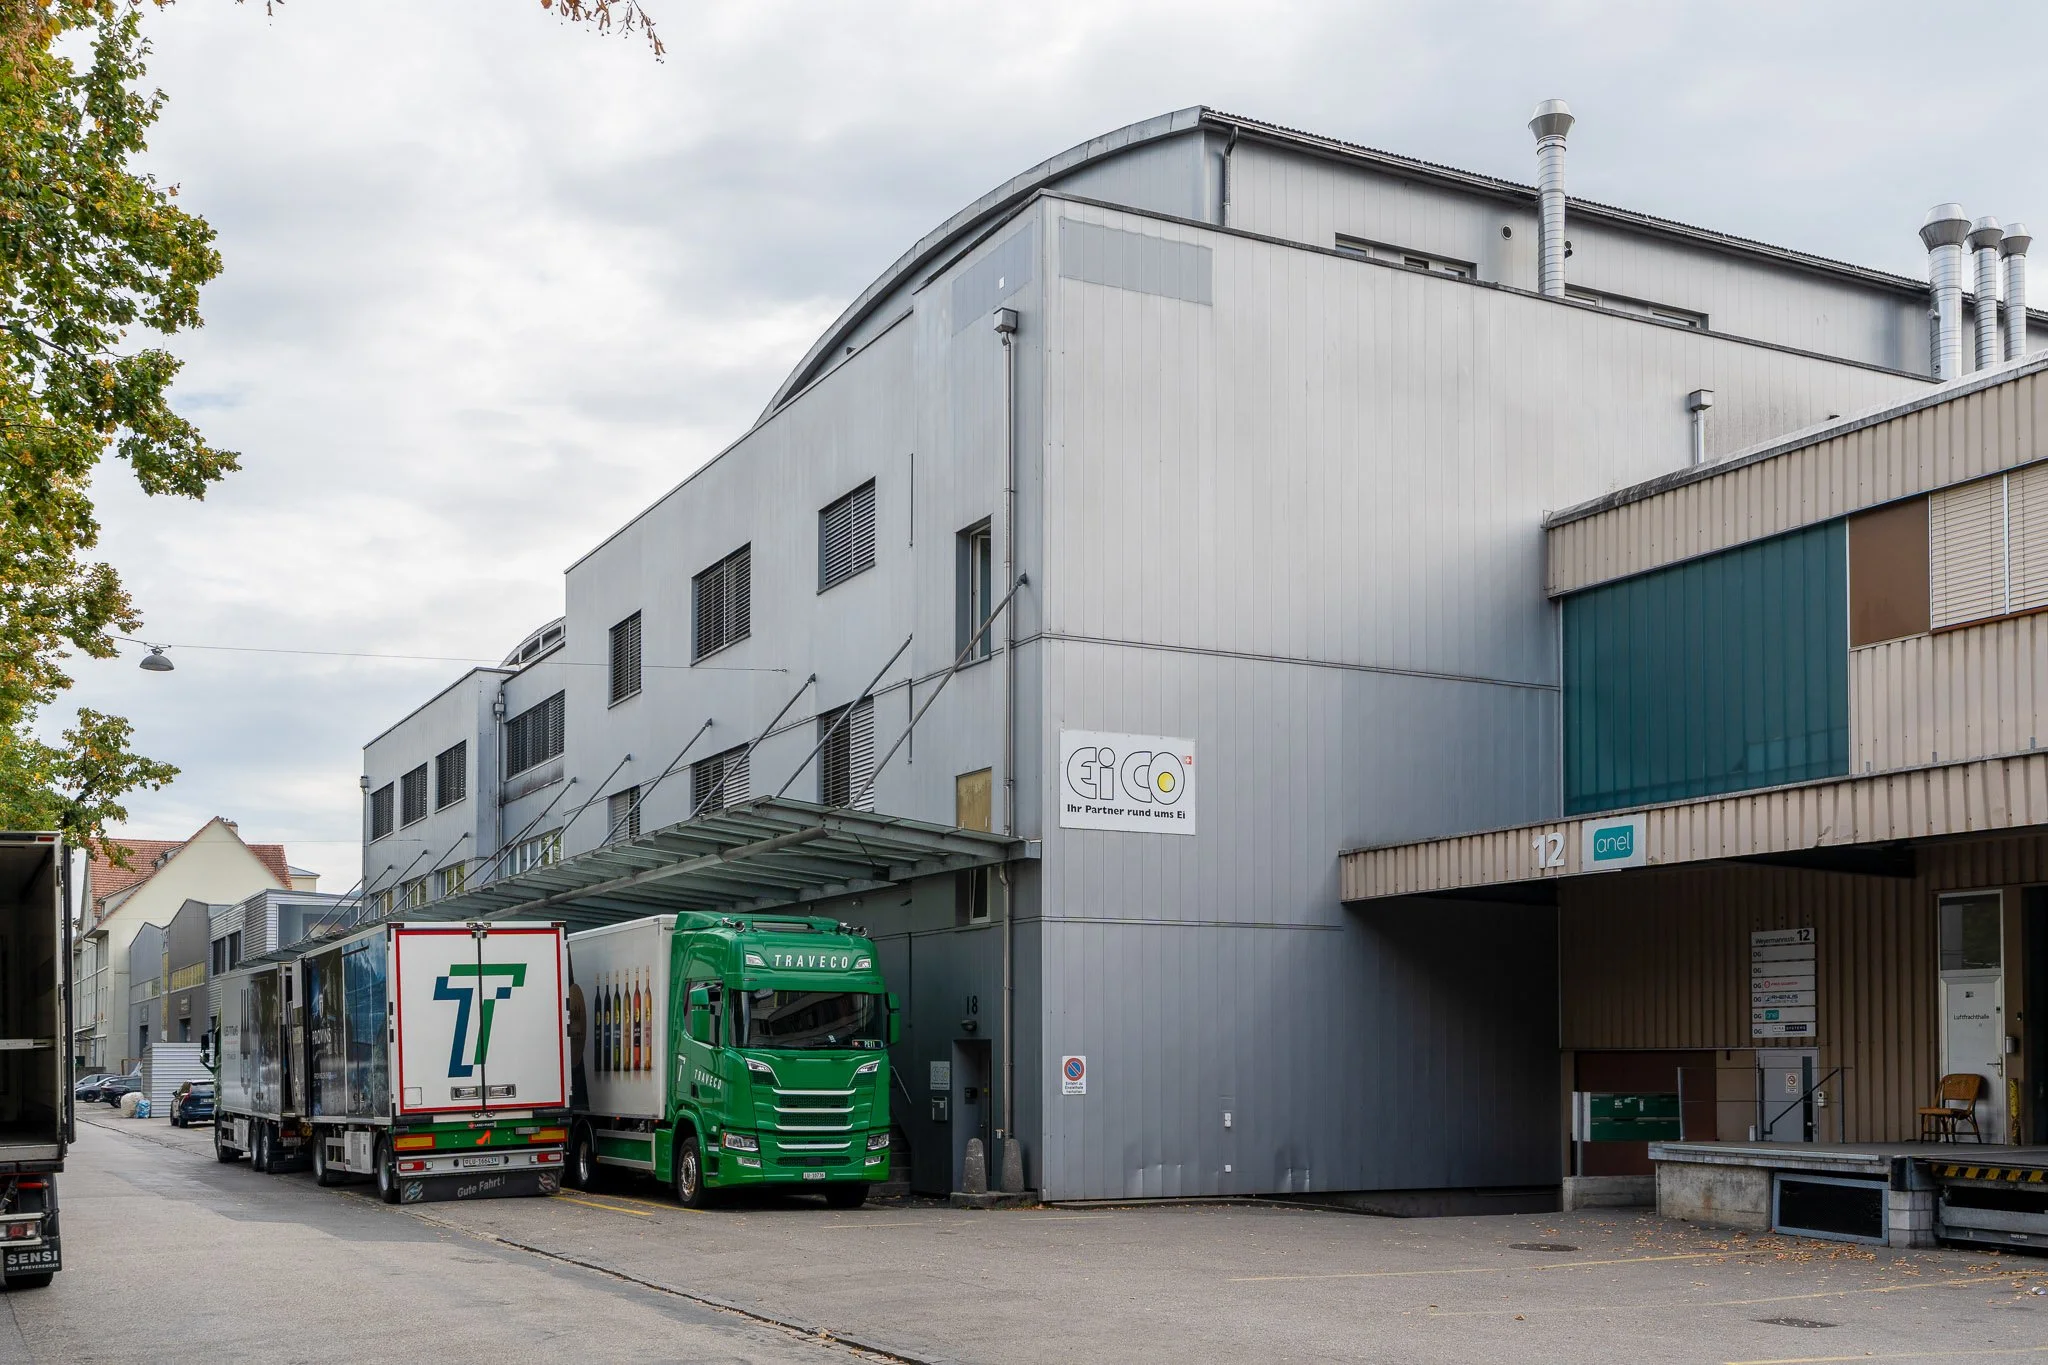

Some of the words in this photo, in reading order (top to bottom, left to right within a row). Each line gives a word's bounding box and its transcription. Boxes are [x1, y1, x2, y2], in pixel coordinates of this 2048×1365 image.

[1067, 804, 1082, 813] Ihr
[1085, 805, 1124, 815] Partner
[1127, 809, 1151, 817] rund
[1177, 811, 1185, 819] Ei
[1531, 832, 1565, 868] 12
[1596, 832, 1630, 853] anel
[1796, 929, 1811, 942] 12
[774, 954, 848, 968] TRAVECO
[966, 995, 979, 1015] 18
[694, 1069, 722, 1090] TRAVECO
[457, 1185, 477, 1198] Gute
[7, 1250, 58, 1265] SENSI
